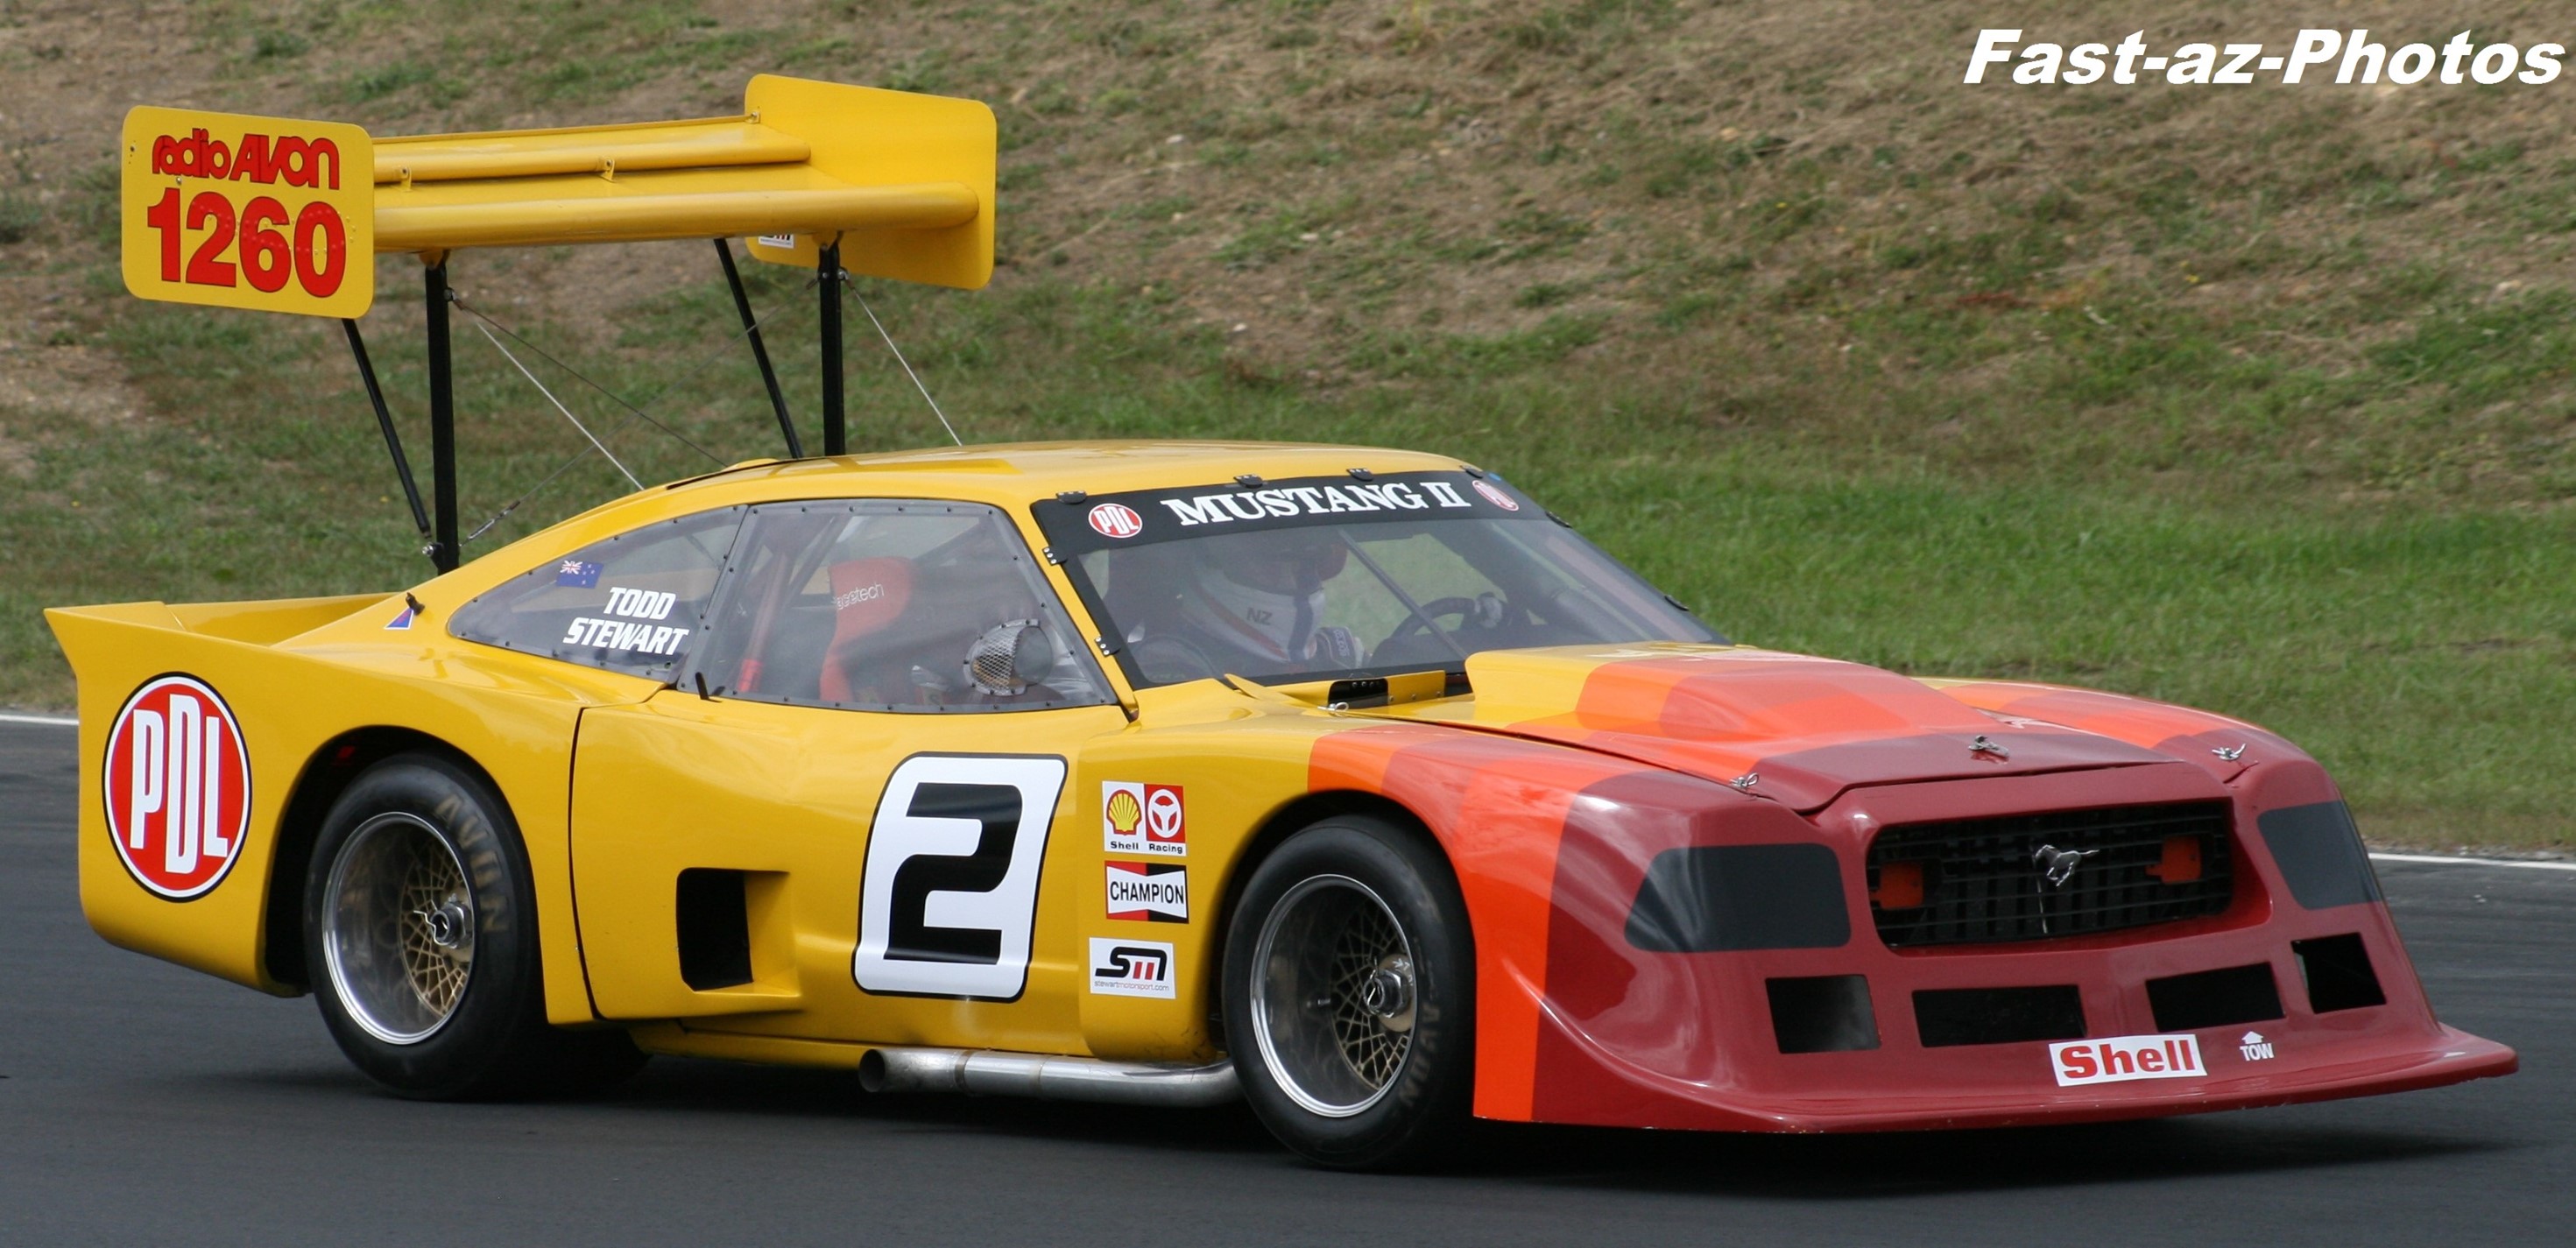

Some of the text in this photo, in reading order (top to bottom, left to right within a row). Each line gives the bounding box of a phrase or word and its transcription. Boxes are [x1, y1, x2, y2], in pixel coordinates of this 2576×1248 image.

[152, 127, 232, 180] radio
[147, 187, 347, 298] 1260
[1093, 505, 1140, 535] PDL
[1160, 483, 1429, 525] MUSTANG
[1420, 482, 1471, 508] II
[603, 587, 676, 620] TODD
[1246, 607, 1273, 625] NZ
[562, 617, 690, 655] STEWART
[130, 694, 229, 874] PDL
[1110, 841, 1183, 854] Shell Racing
[883, 782, 1023, 965] 2
[1110, 881, 1184, 904] CHAMPION
[1094, 981, 1169, 991] stewartmotorsport.com
[2059, 1039, 2196, 1079] Shell
[2240, 1042, 2275, 1061] TOW
